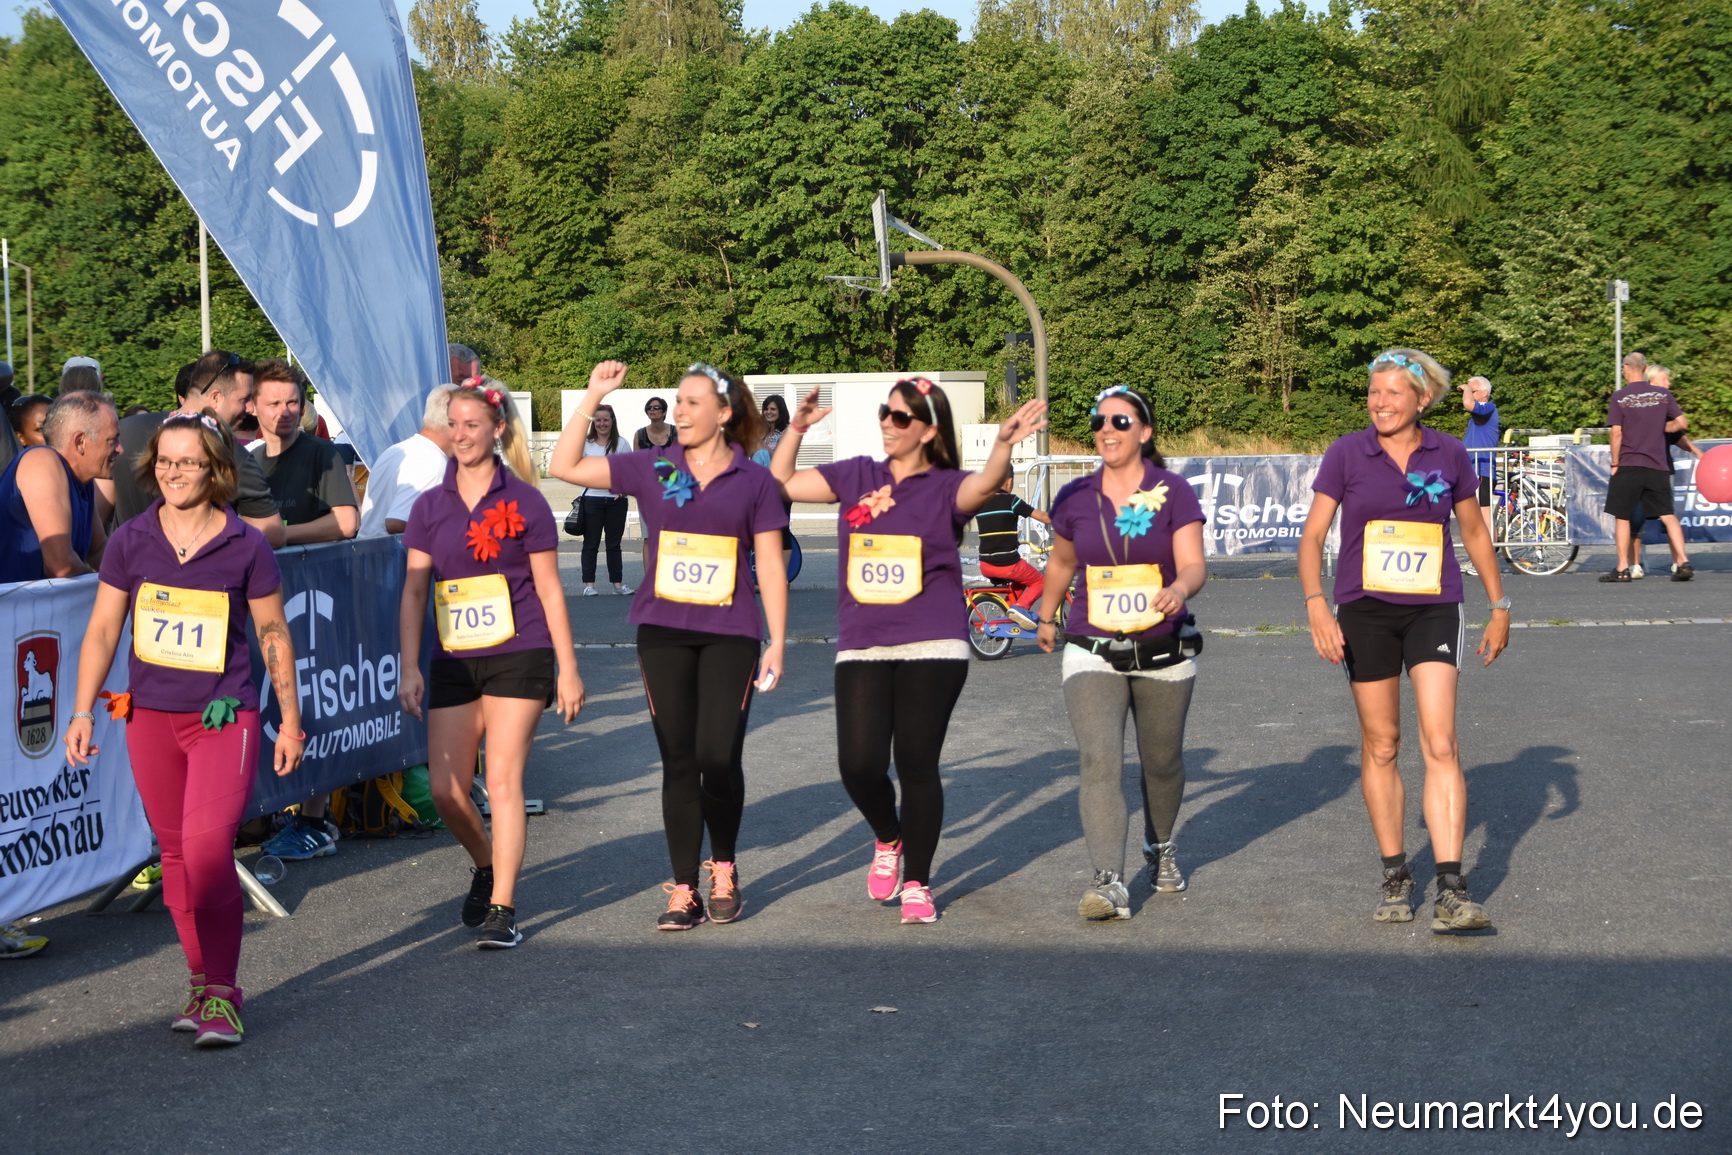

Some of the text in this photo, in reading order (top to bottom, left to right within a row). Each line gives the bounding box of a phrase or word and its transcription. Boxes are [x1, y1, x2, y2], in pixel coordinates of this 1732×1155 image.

[1198, 496, 1310, 525] ische
[1680, 515, 1732, 527] AUTO
[1203, 526, 1303, 541] AUTOMOBIL
[673, 561, 719, 585] 697
[861, 562, 905, 584] 699
[1380, 550, 1428, 573] 707
[1102, 592, 1147, 614] 700
[449, 604, 496, 630] 705
[153, 617, 203, 648] 711
[25, 726, 47, 747] 1628
[302, 710, 401, 761] AUTOMOBILE
